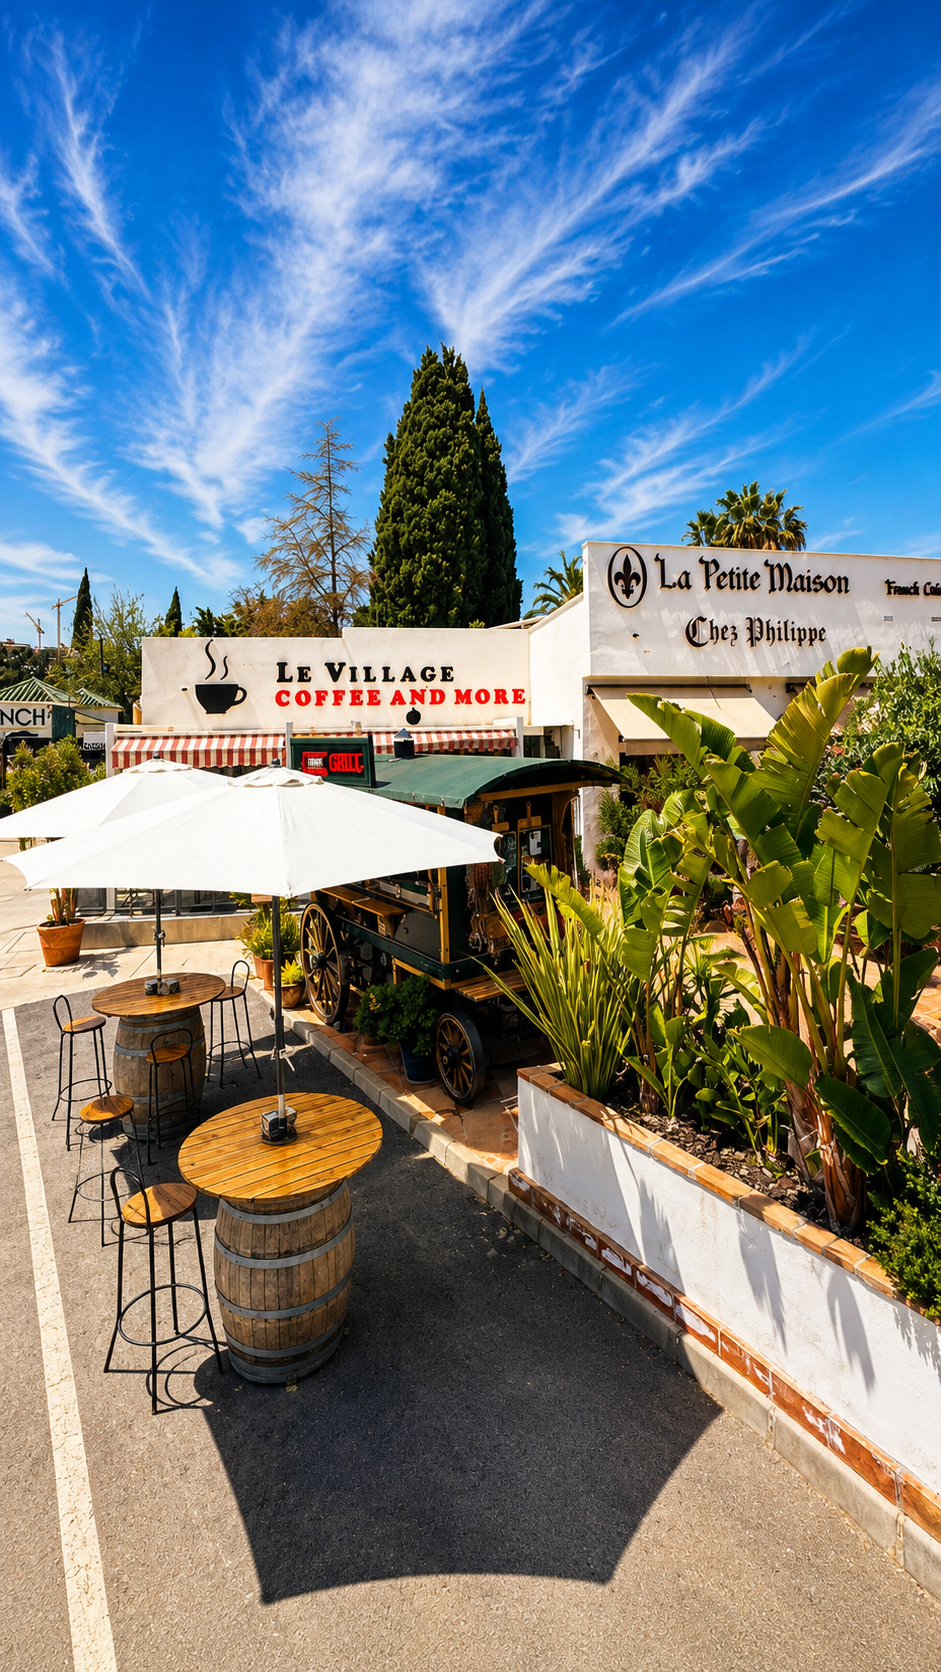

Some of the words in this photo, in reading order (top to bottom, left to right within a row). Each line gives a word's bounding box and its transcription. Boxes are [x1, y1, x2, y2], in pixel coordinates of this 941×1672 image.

[654, 552, 692, 590] La
[699, 555, 761, 592] Petite
[763, 558, 850, 594] Maison
[685, 615, 738, 648] Chez
[745, 616, 827, 648] Philippe
[275, 689, 382, 707] COFFEE
[389, 688, 446, 706] AND
[454, 688, 526, 705] MORE
[328, 752, 365, 774] GRILL
